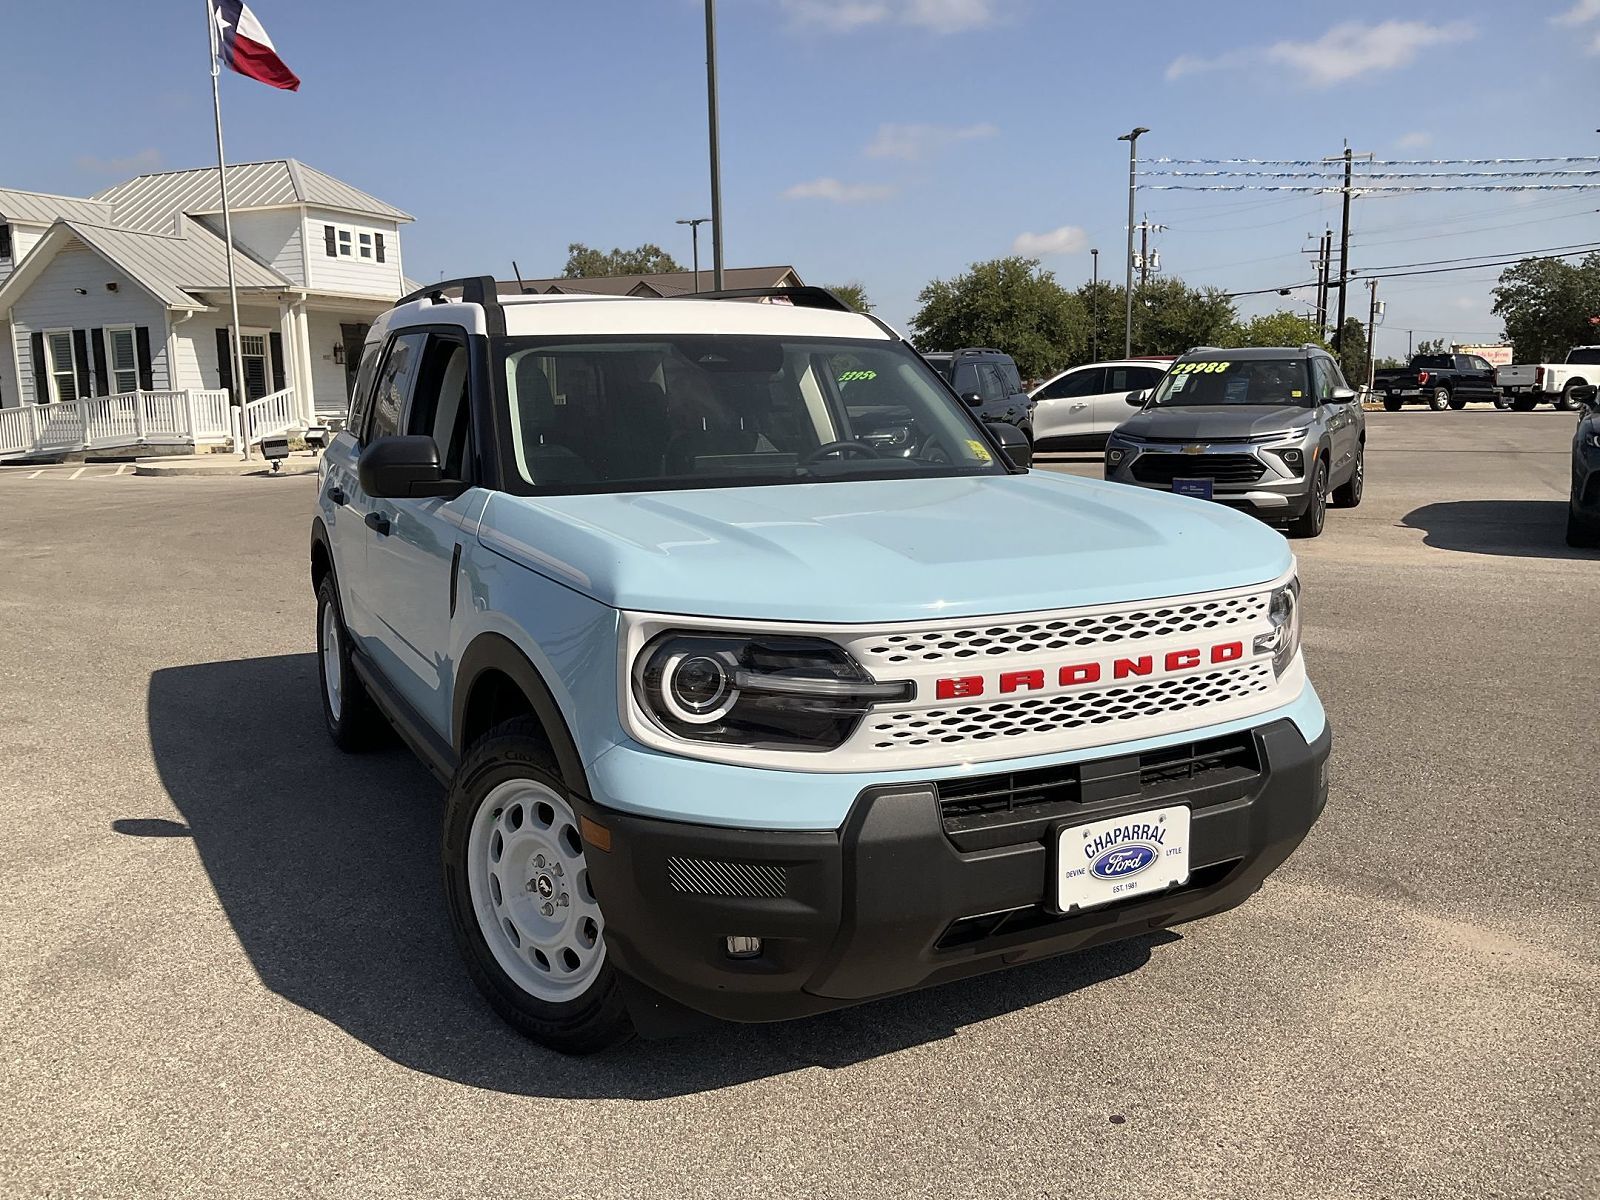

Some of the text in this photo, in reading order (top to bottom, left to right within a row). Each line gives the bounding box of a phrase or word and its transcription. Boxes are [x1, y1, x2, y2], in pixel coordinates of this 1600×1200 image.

[1170, 361, 1231, 375] 29988
[936, 640, 1243, 700] BRONCO
[1084, 824, 1167, 859] CHAPARRAL
[1166, 847, 1182, 857] LYTLE
[1105, 850, 1142, 875] Ford
[1066, 868, 1086, 879] DEVINE
[1112, 881, 1138, 894] EST. 1981
